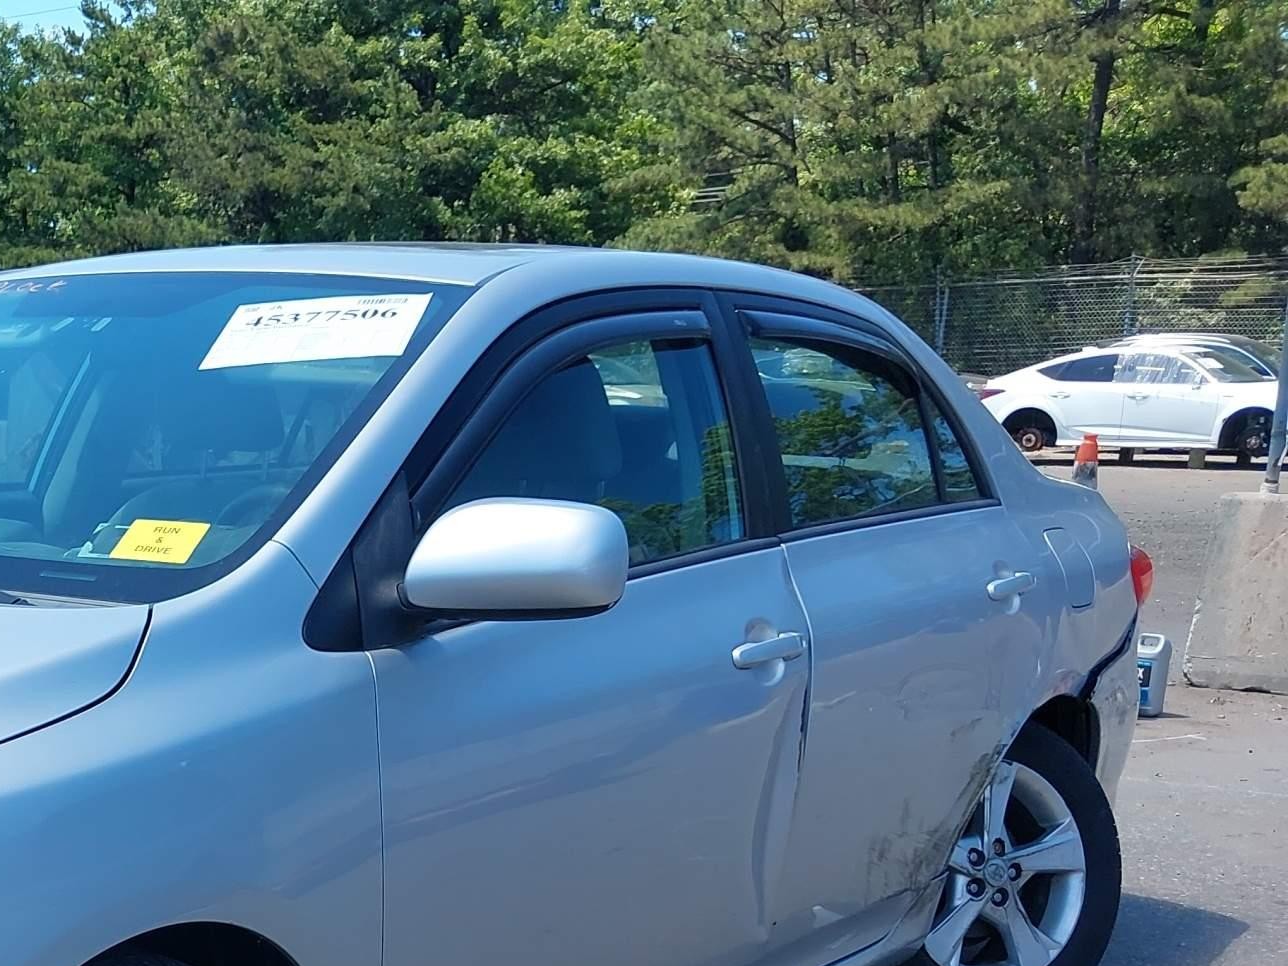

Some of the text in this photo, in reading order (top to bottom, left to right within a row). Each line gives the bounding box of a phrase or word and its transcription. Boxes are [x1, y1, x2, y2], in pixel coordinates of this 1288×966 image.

[245, 308, 398, 327] 45377506
[153, 526, 181, 534] RUN
[155, 536, 164, 544] &
[134, 545, 173, 555] DRIVE
